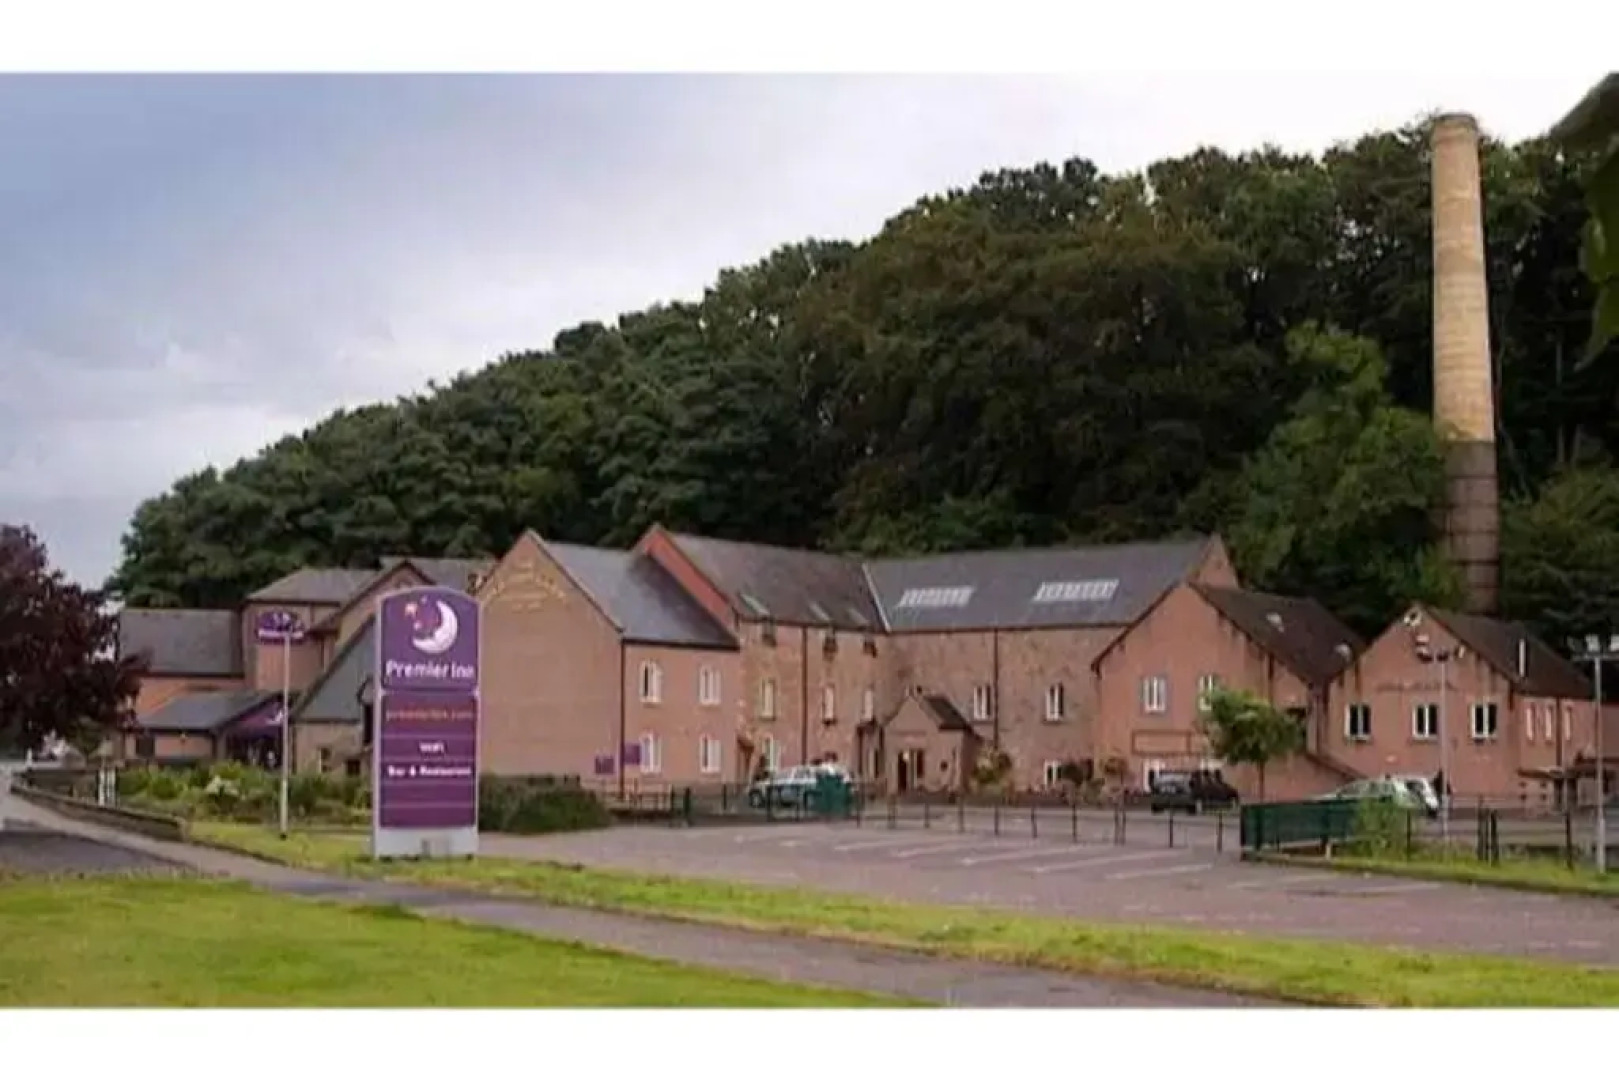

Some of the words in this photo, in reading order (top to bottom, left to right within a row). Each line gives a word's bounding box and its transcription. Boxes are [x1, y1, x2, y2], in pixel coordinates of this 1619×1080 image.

[385, 659, 449, 678] Premier
[451, 659, 474, 678] Inn
[387, 764, 405, 776] Bar
